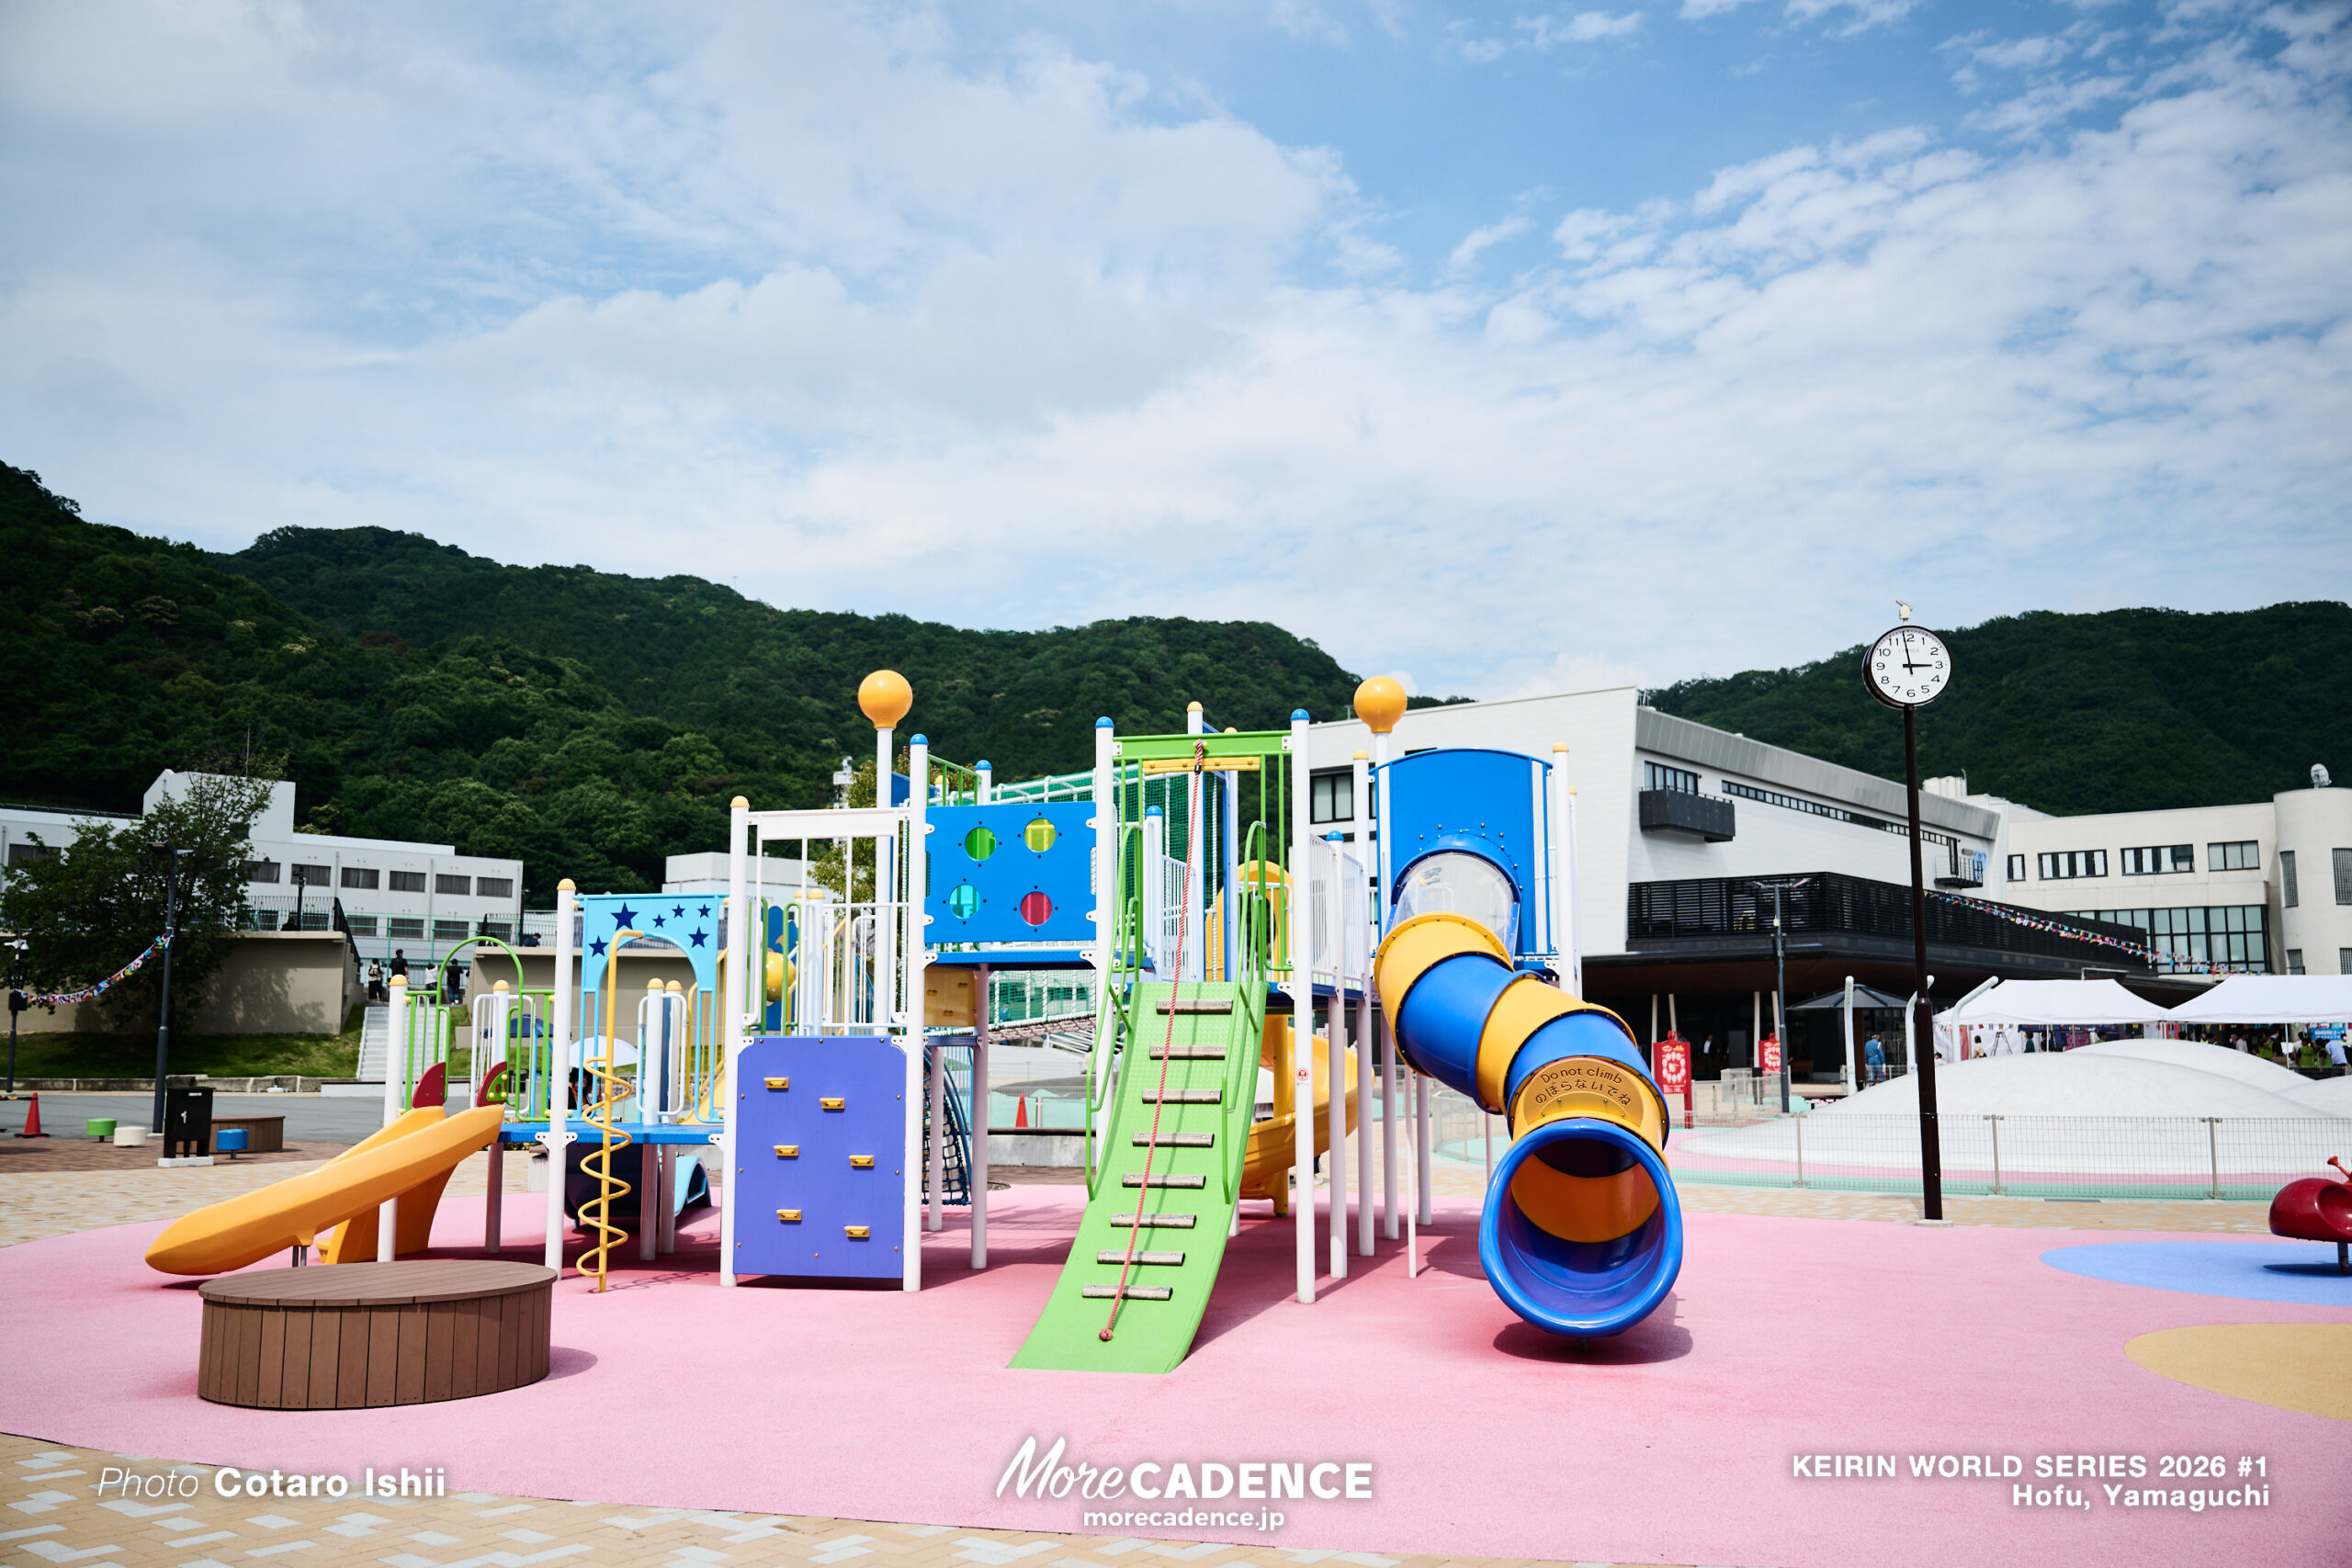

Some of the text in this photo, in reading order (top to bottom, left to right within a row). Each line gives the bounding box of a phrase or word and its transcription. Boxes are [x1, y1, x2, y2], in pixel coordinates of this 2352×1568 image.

[1888, 637, 1899, 646] 11
[1921, 637, 1926, 646] 1
[1879, 649, 1891, 657] 10
[1930, 647, 1939, 656] 2
[1876, 662, 1885, 671] 9
[1935, 660, 1943, 669] 3
[1881, 675, 1890, 684] 8
[1931, 674, 1940, 682] 4
[1893, 685, 1901, 694] 7
[1906, 689, 1916, 698] 6
[1920, 685, 1930, 694] 5
[1540, 1066, 1623, 1084] Do not climb
[1535, 1078, 1632, 1106] のぼらないでね
